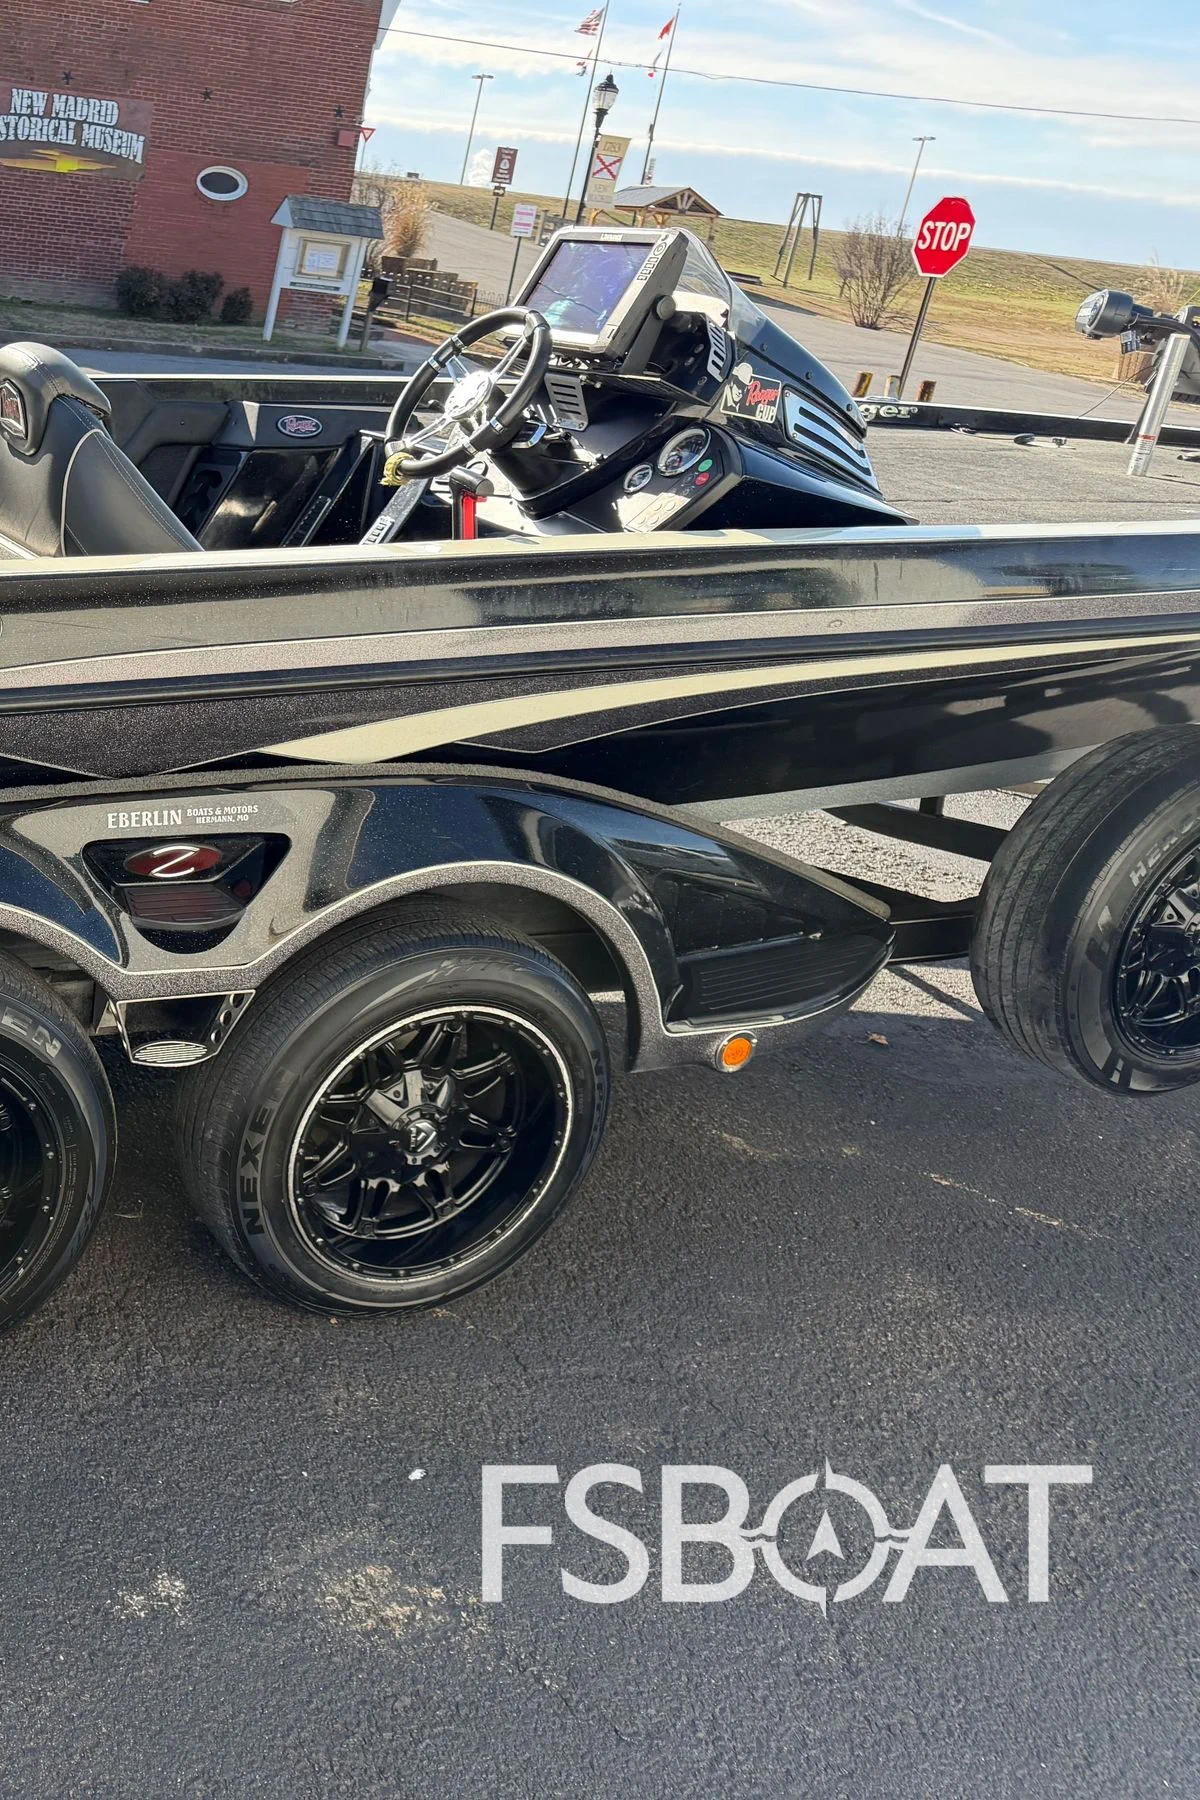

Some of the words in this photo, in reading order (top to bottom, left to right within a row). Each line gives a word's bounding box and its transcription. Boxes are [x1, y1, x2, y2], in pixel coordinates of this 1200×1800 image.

[10, 88, 49, 116] NEW
[51, 93, 120, 126] MADRID
[80, 122, 146, 164] MUSEUM
[918, 220, 971, 251] STOP
[858, 404, 912, 421] ger
[107, 809, 182, 829] EBERLIN
[186, 807, 213, 817] BOATS
[214, 807, 222, 815] &
[223, 804, 258, 815] MOTORS
[236, 813, 249, 821] MO
